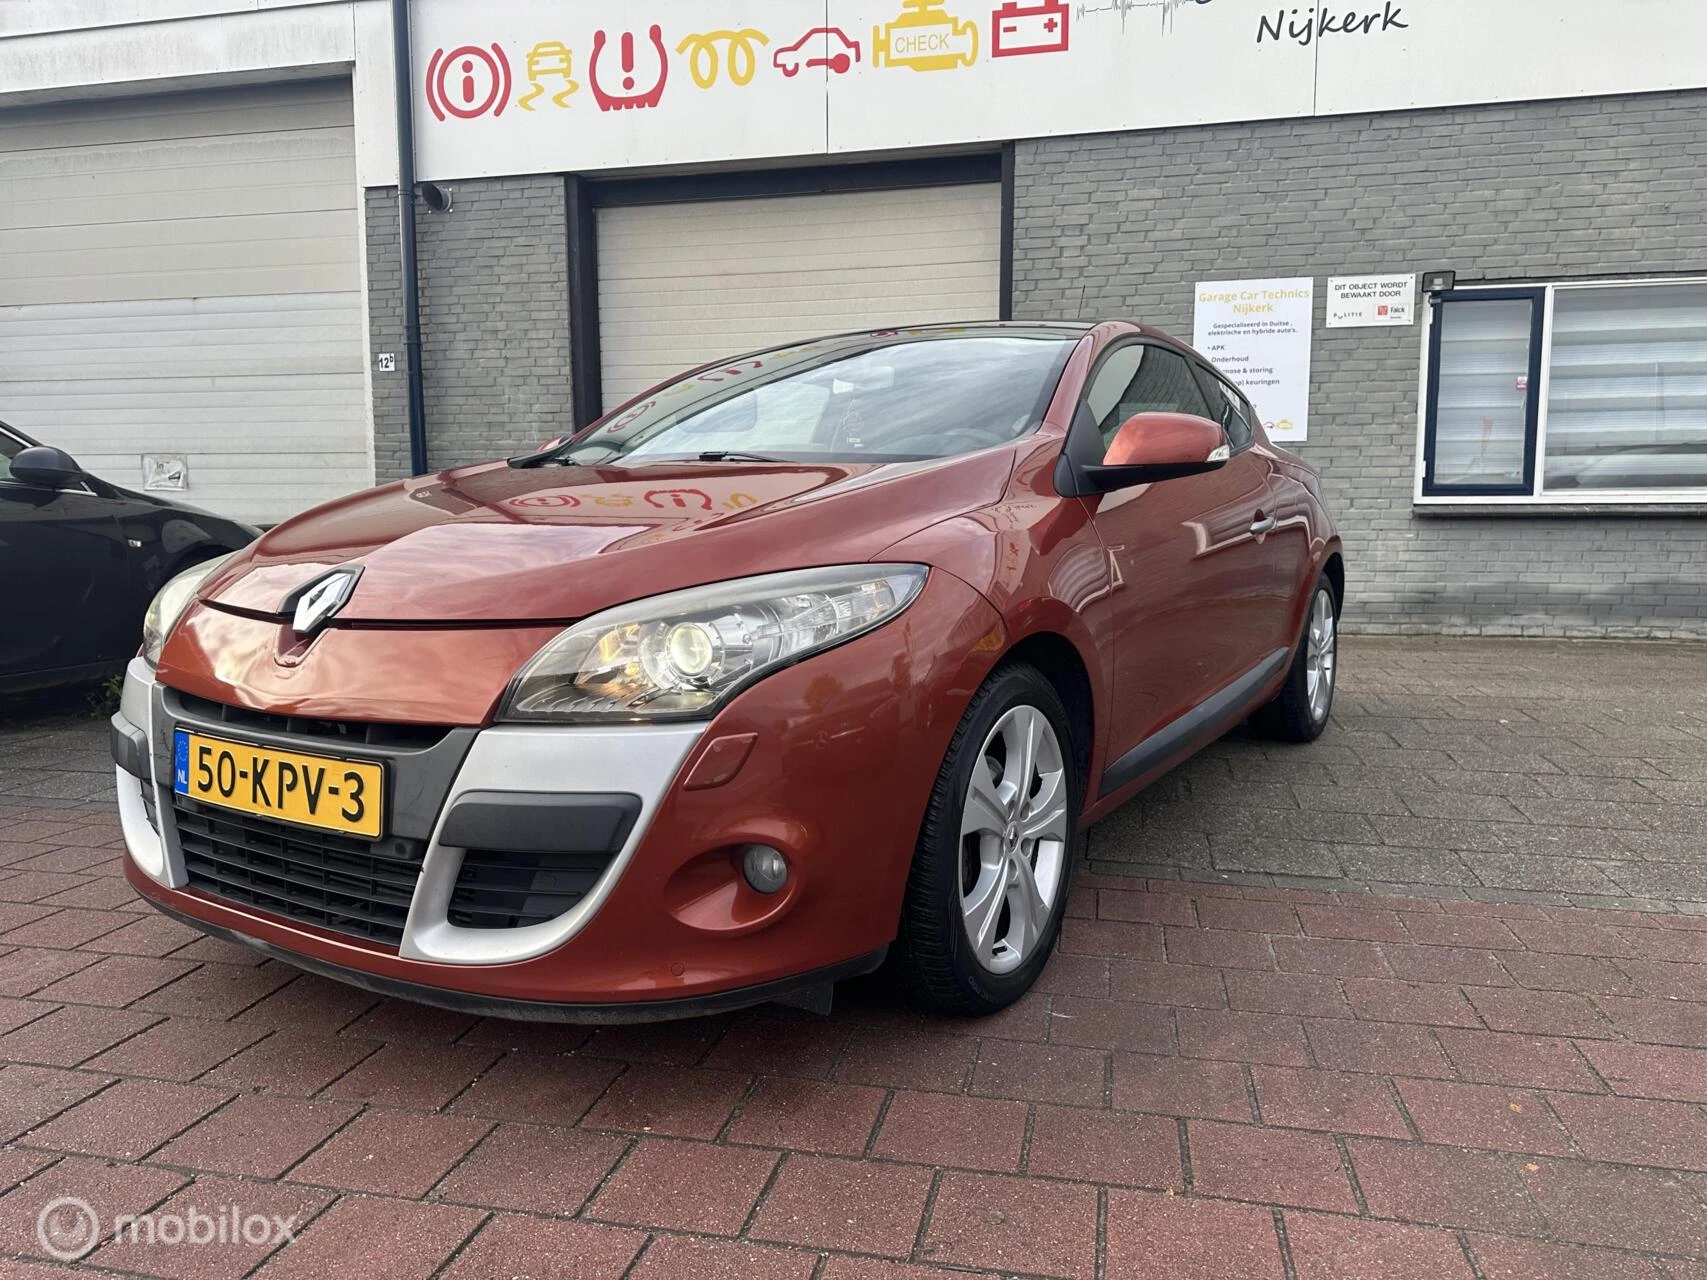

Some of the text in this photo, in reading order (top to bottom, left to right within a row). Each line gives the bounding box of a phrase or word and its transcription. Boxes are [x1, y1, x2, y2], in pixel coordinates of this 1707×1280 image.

[1256, 1, 1409, 46] Nijkerk
[894, 33, 950, 53] CHECK
[1349, 282, 1378, 290] OBJECT
[1381, 281, 1408, 289] WORDT
[1199, 288, 1310, 304] Garage Car Technics
[1340, 290, 1402, 299] BEWAAKT DOOR
[1233, 303, 1274, 316] Nijkerk
[1213, 321, 1261, 330] Gespecialiseerd
[1269, 320, 1289, 328] Duitse
[1252, 327, 1276, 336] hybride
[1249, 367, 1273, 375] storing
[1245, 379, 1280, 387] keuringen
[177, 768, 188, 785] NL
[197, 745, 365, 823] 50-KPV-3
